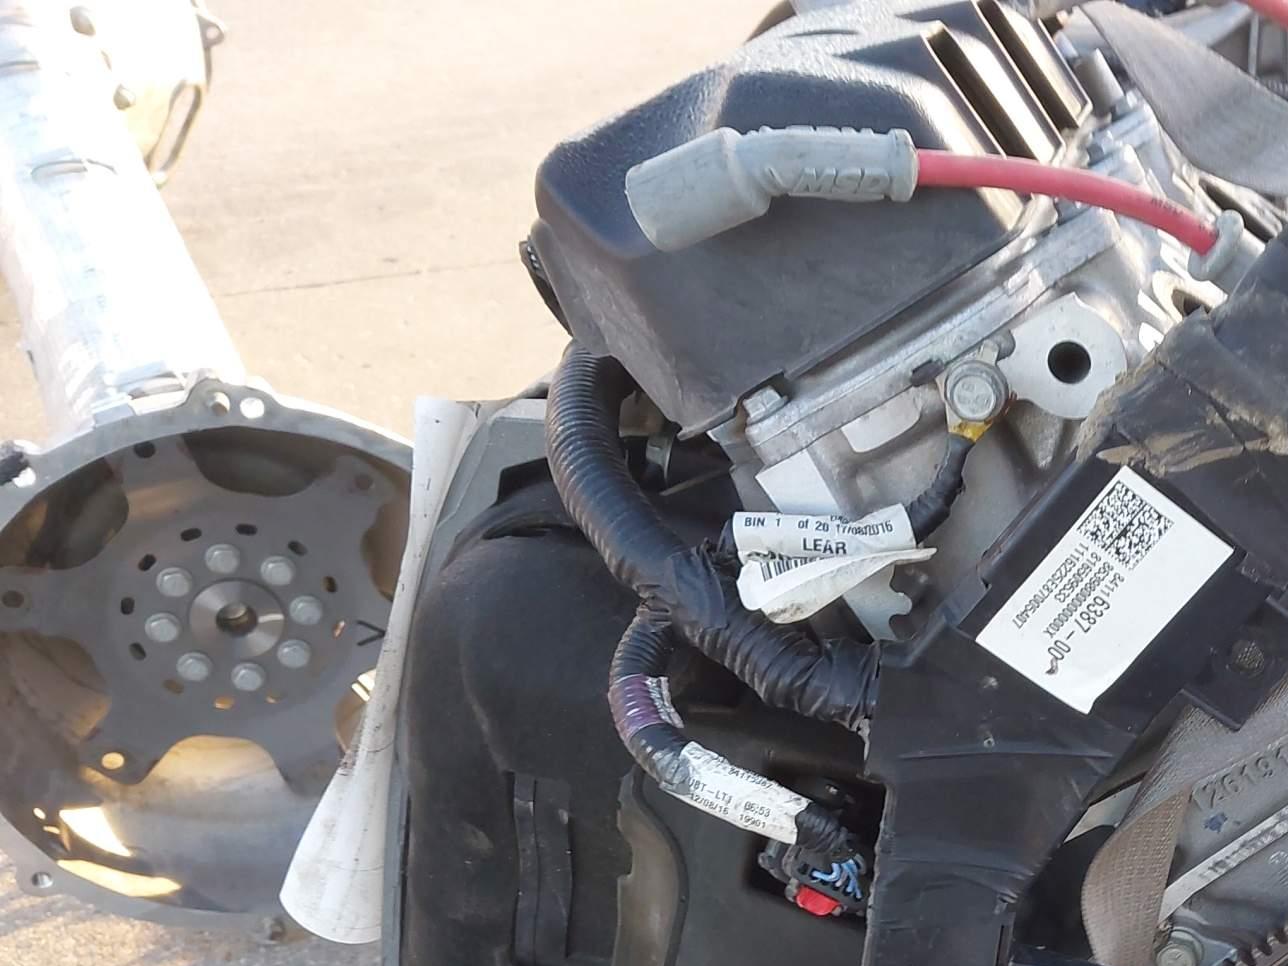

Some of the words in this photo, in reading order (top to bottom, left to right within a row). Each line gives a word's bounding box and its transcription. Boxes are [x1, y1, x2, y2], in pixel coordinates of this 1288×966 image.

[792, 167, 890, 195] MSD
[744, 516, 766, 528] BIN
[775, 517, 782, 527] 1
[798, 519, 809, 530] of
[802, 538, 848, 555] LEAR
